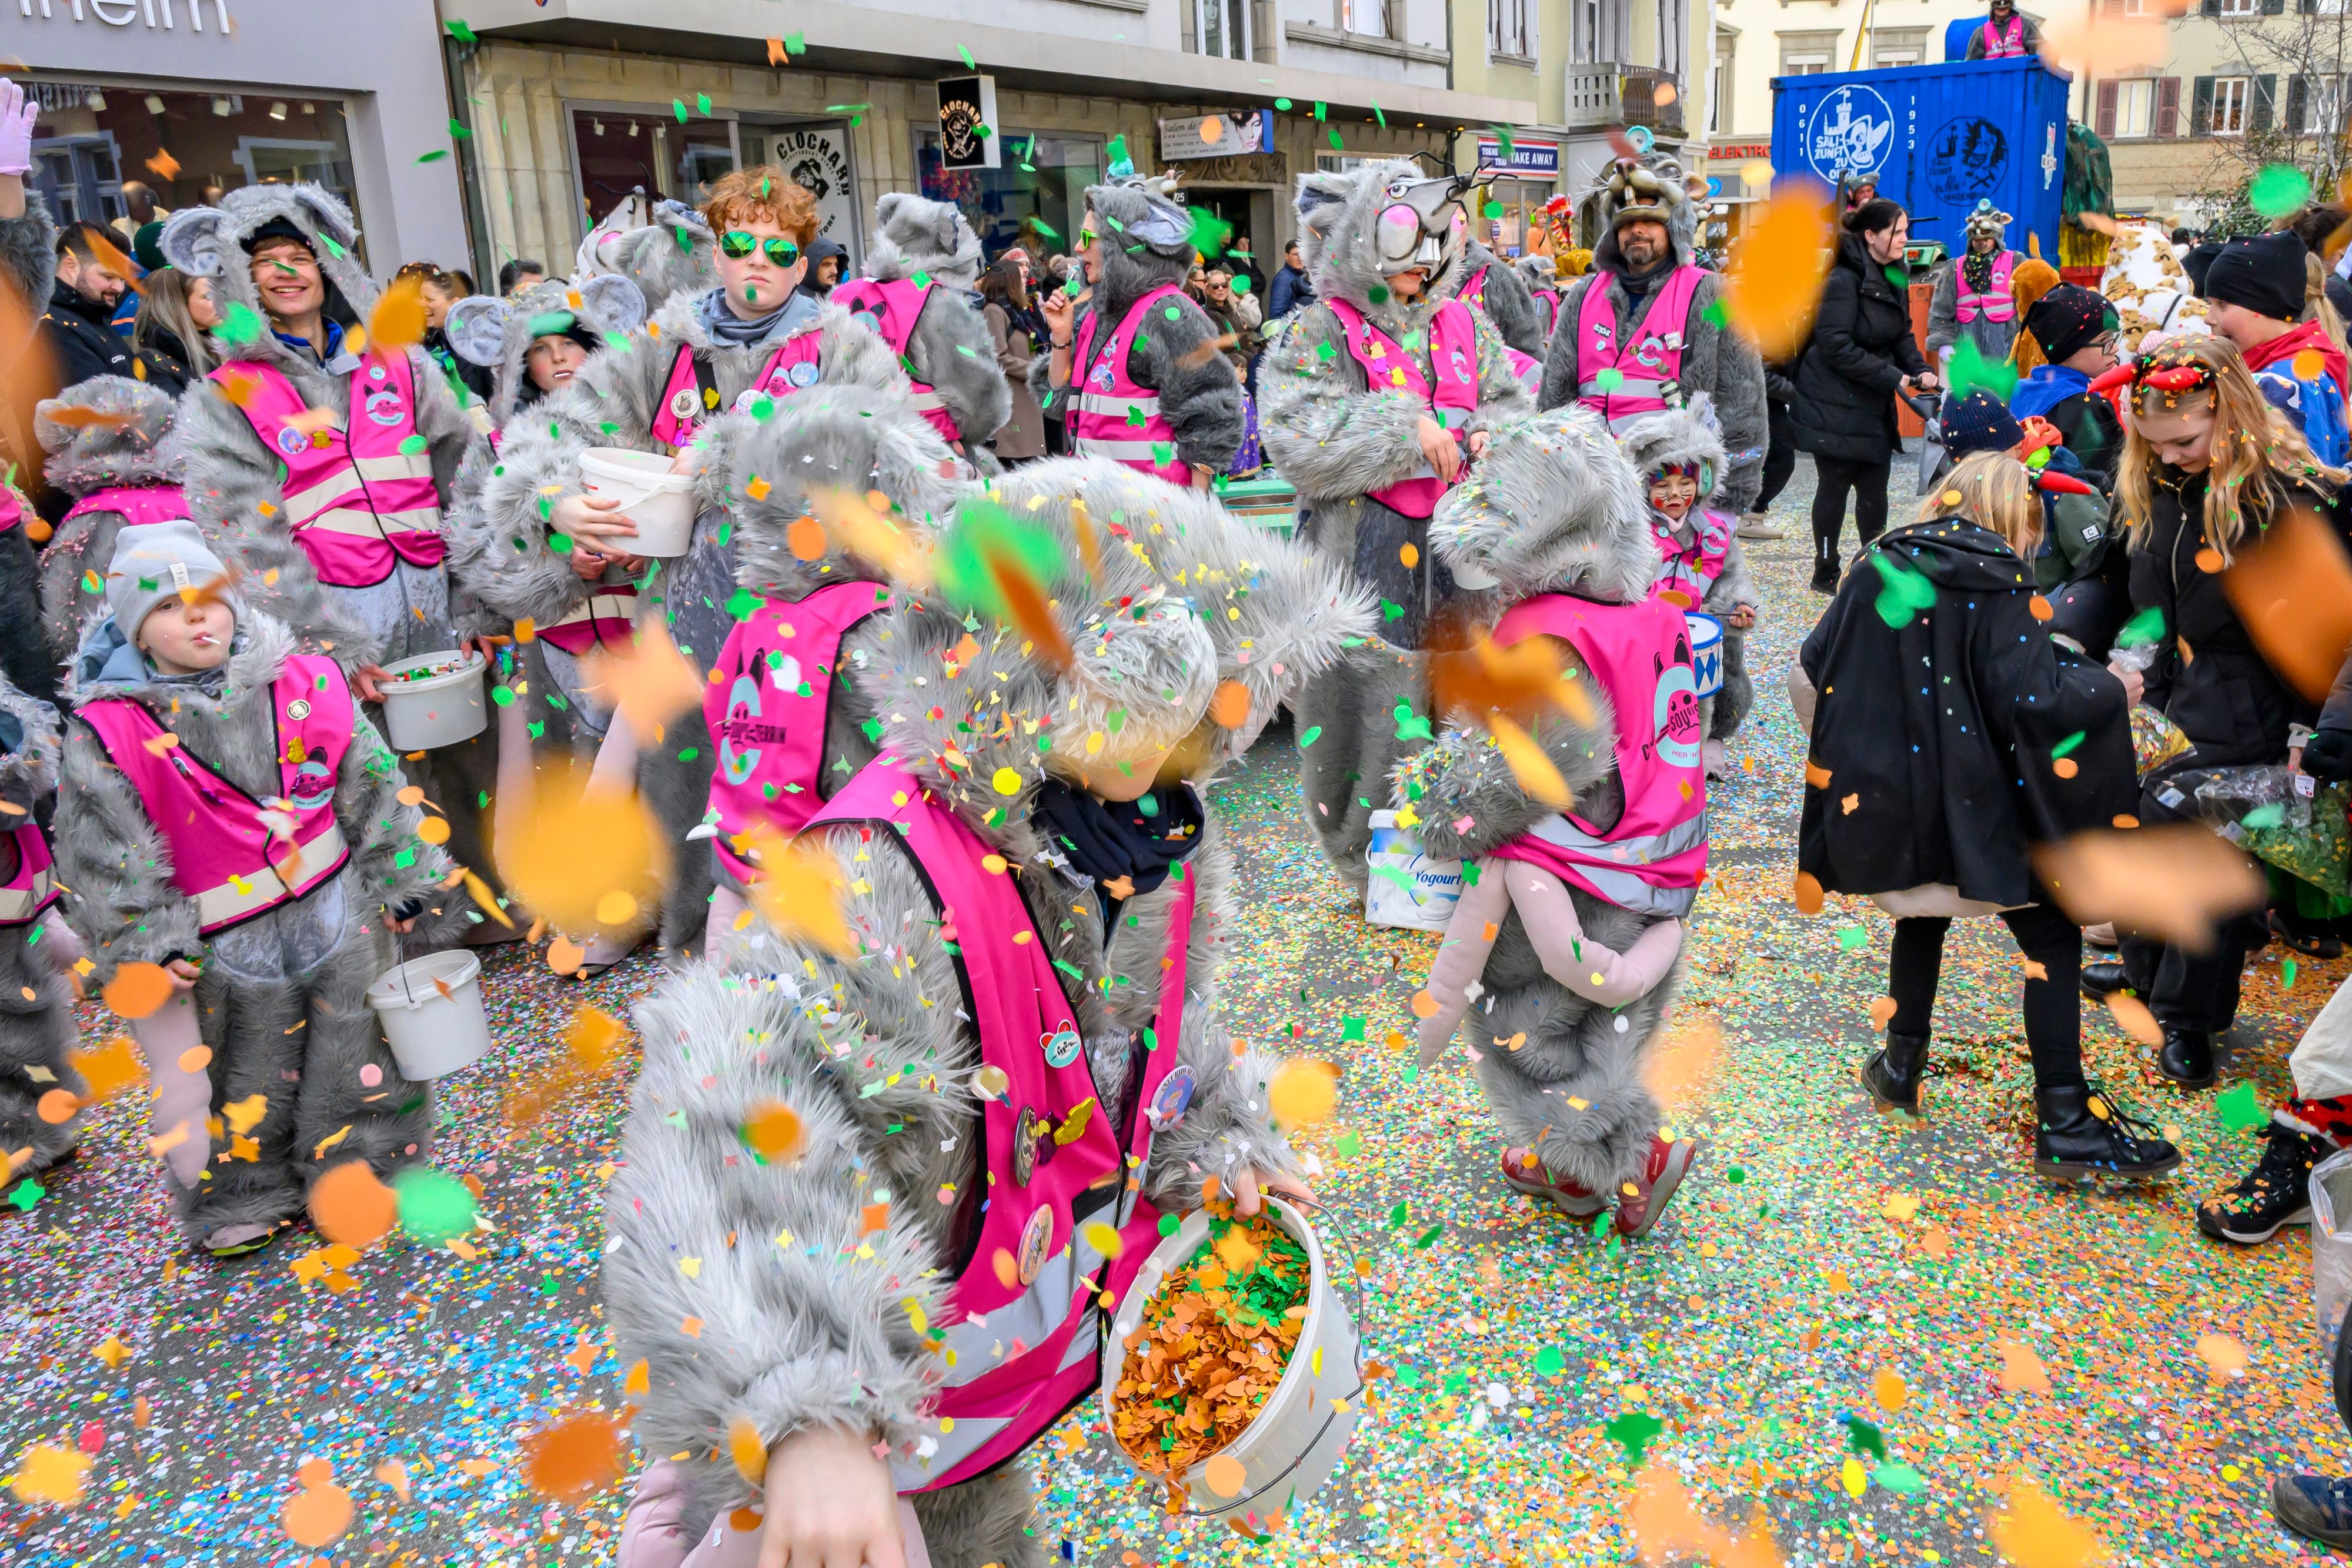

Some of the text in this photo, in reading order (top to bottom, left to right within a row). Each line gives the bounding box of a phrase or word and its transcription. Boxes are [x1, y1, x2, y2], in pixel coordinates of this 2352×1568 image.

[1187, 121, 1197, 131] de
[1511, 152, 1553, 165] TAKE AWAY
[1814, 146, 1844, 160] ZUNFT
[776, 132, 850, 196] CLOCHARD
[1835, 158, 1848, 168] ZU
[1176, 192, 1185, 202] 25
[1671, 704, 1698, 732] SOURIS
[1672, 750, 1688, 758] MER
[1416, 870, 1462, 887] Yogourt
[1373, 900, 1378, 911] kg
